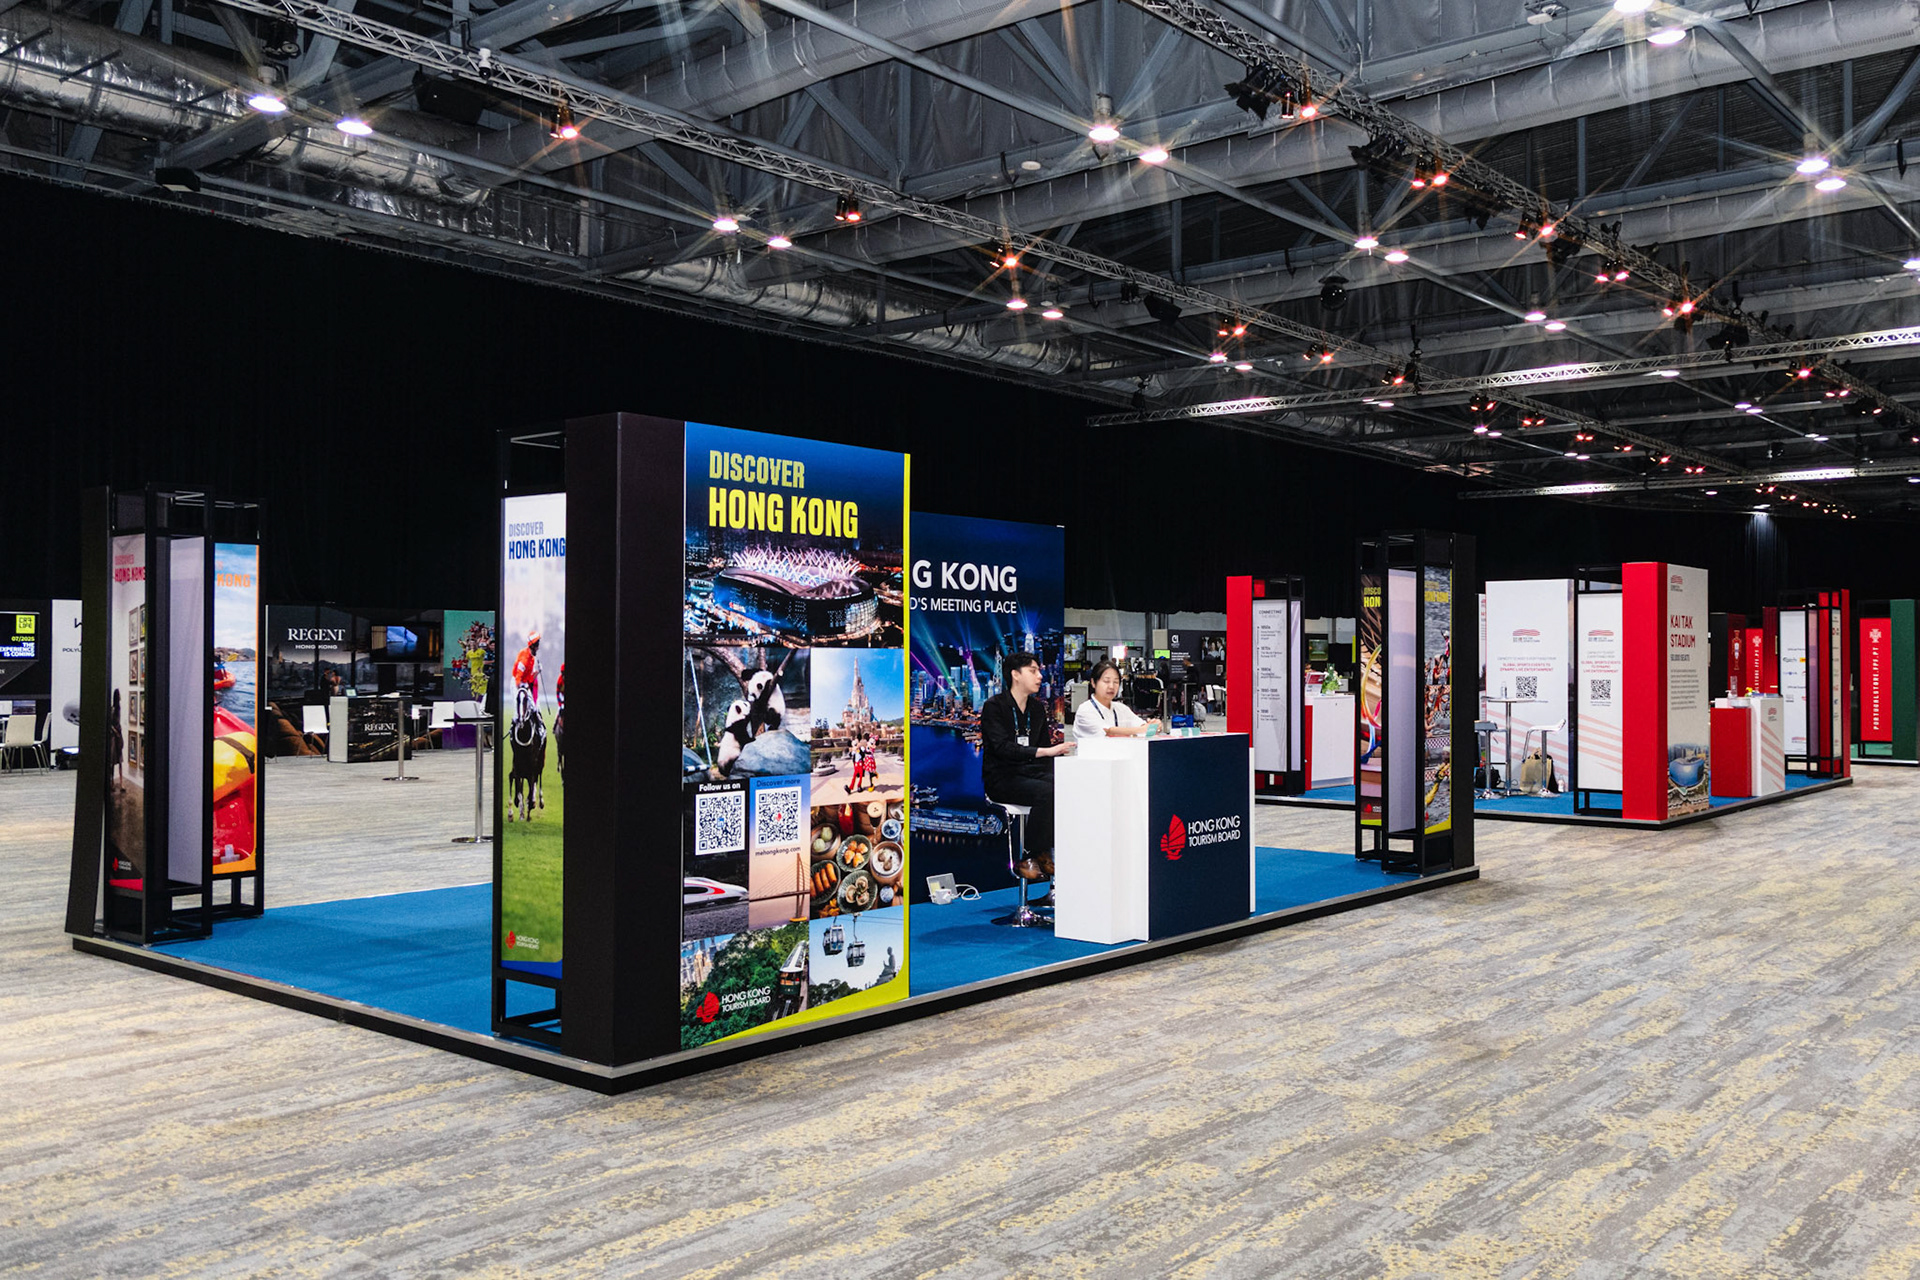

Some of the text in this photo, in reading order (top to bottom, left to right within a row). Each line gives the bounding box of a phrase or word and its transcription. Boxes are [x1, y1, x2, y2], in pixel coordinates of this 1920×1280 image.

[709, 449, 805, 488] DISCOVER
[708, 486, 859, 539] HONG KONG
[508, 521, 544, 537] DISCOVER
[508, 537, 566, 560] HONG KONG
[216, 573, 251, 588] KONG
[941, 561, 1017, 593] KONG
[930, 597, 982, 613] MEETING
[984, 600, 1017, 614] PLACE
[1670, 614, 1693, 629] KAI TAK
[287, 628, 346, 641] REGENT
[1670, 633, 1696, 648] STADIUM
[364, 722, 396, 732] REGENT
[699, 783, 722, 791] Follow
[756, 779, 783, 788] Discover
[1188, 814, 1241, 835] HONG KONG
[1188, 829, 1241, 848] TOURISM BOARD
[755, 846, 801, 856] mehongkong.com
[721, 985, 771, 1004] HONG KONG
[722, 995, 771, 1013] TOURISM BOARD
